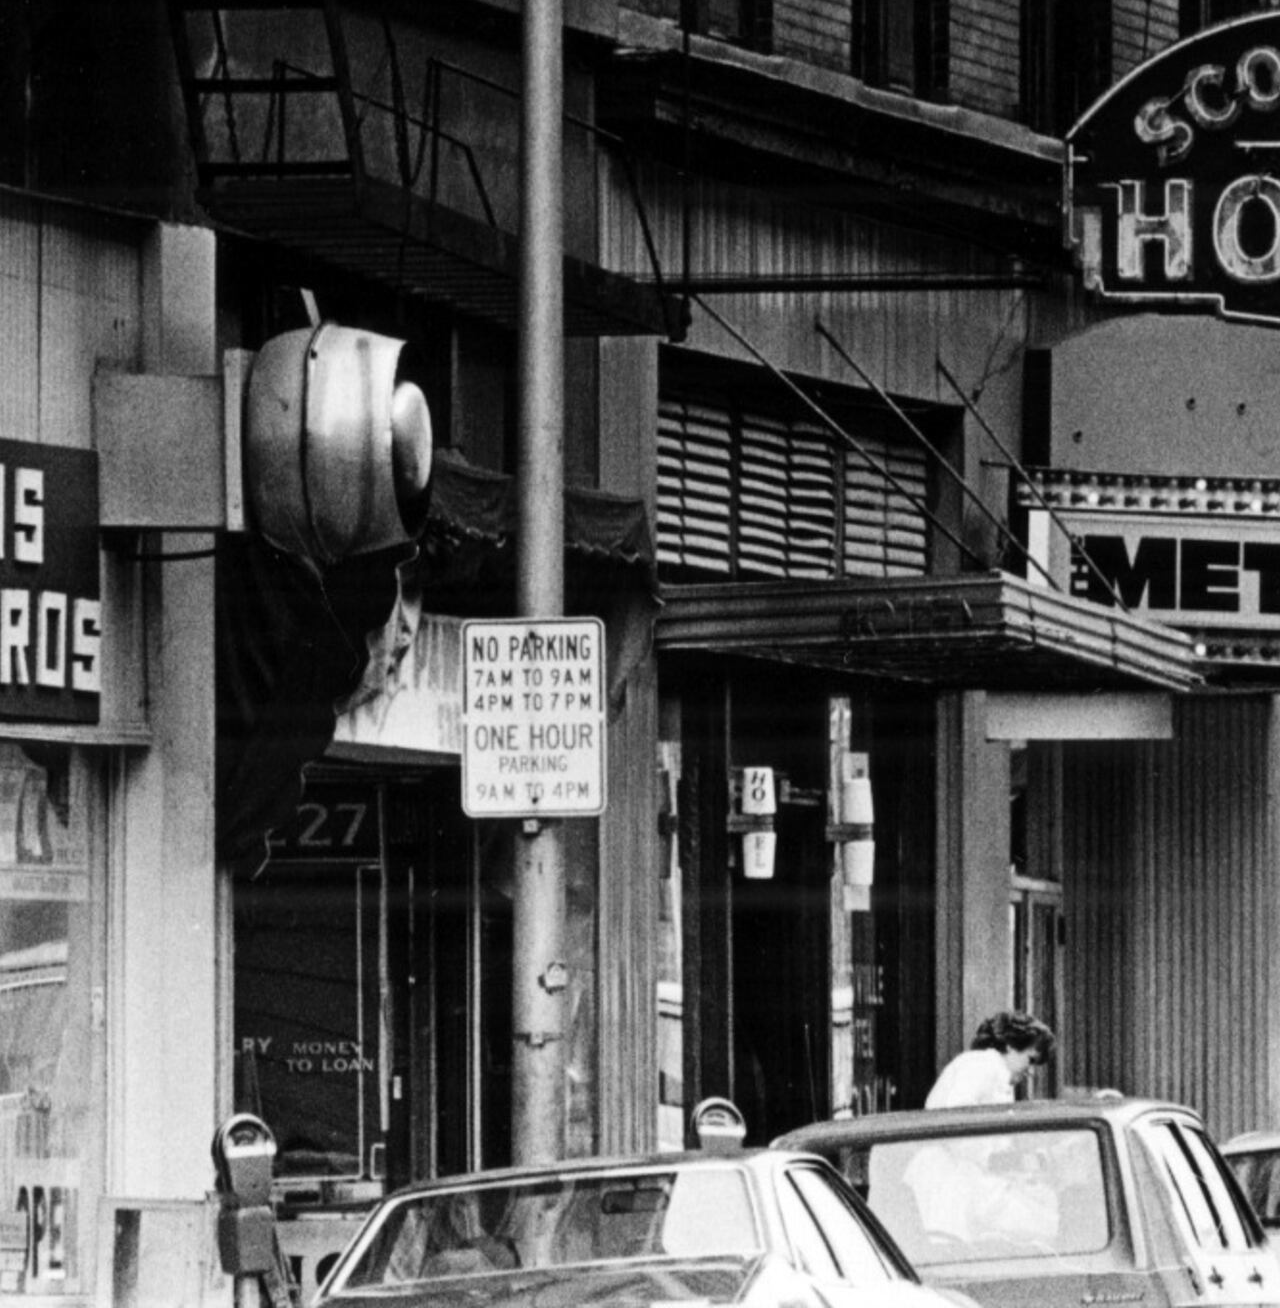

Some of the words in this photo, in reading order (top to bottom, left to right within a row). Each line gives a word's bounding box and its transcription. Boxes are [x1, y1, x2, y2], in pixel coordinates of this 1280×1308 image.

[472, 635, 499, 663] NO
[508, 633, 591, 662] PARKING
[522, 668, 543, 687] TO
[522, 693, 543, 712] TO
[474, 724, 519, 752] ONE
[529, 723, 593, 750] HOUR
[498, 754, 568, 774] PARKING
[525, 781, 545, 801] TO
[292, 1041, 363, 1055] MONEY
[285, 1058, 313, 1074] TO
[321, 1057, 375, 1073] LOAN
